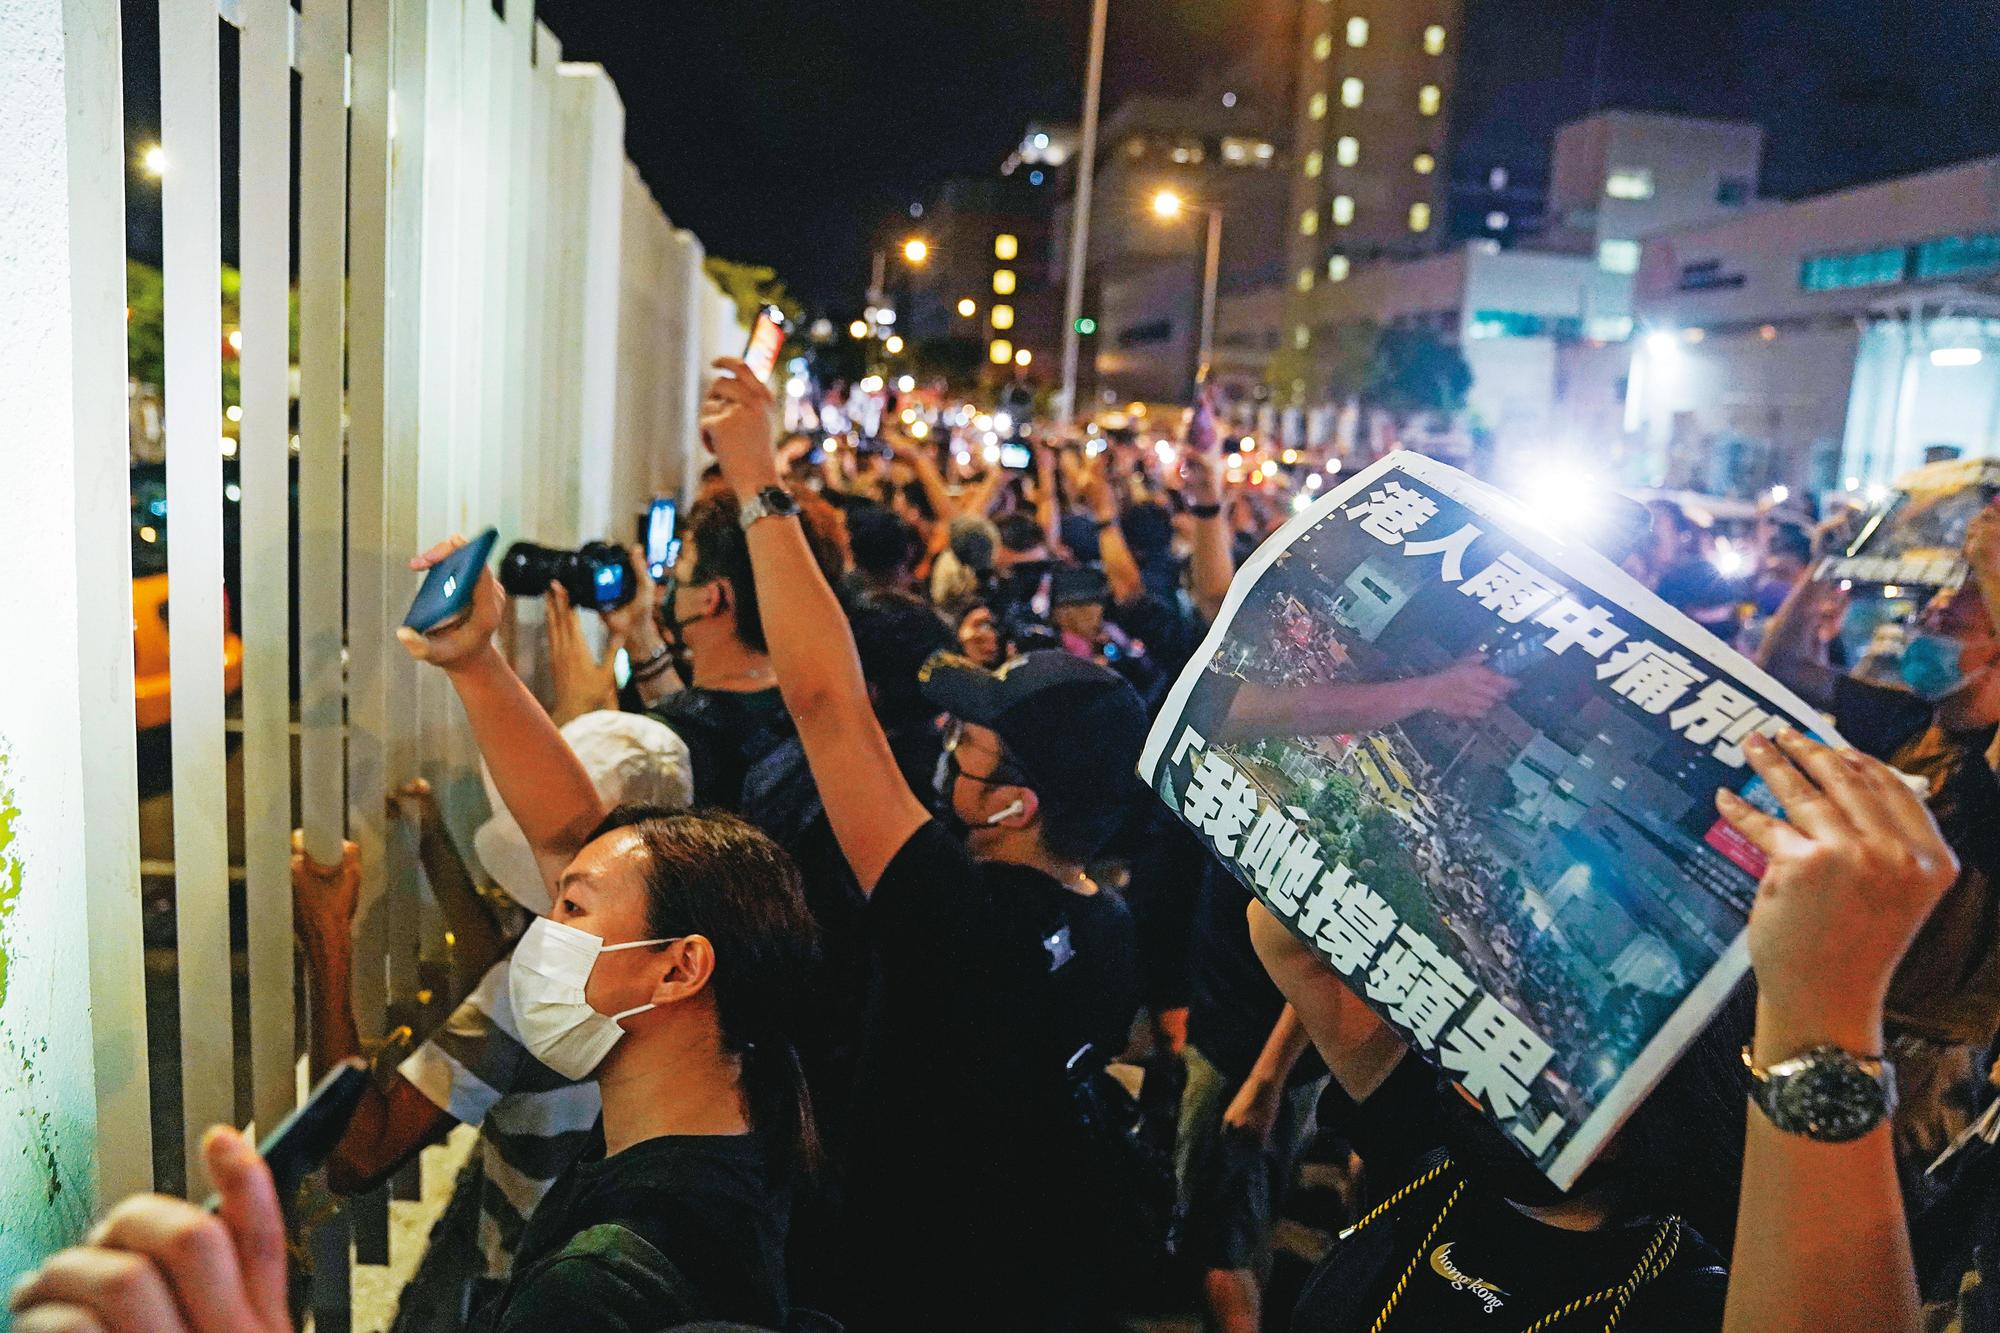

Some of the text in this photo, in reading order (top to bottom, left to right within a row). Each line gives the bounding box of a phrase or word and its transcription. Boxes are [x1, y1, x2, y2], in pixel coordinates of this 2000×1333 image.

[1345, 481, 1792, 768] 港人雨中痛別
[1437, 1248, 1504, 1313] hong kong
